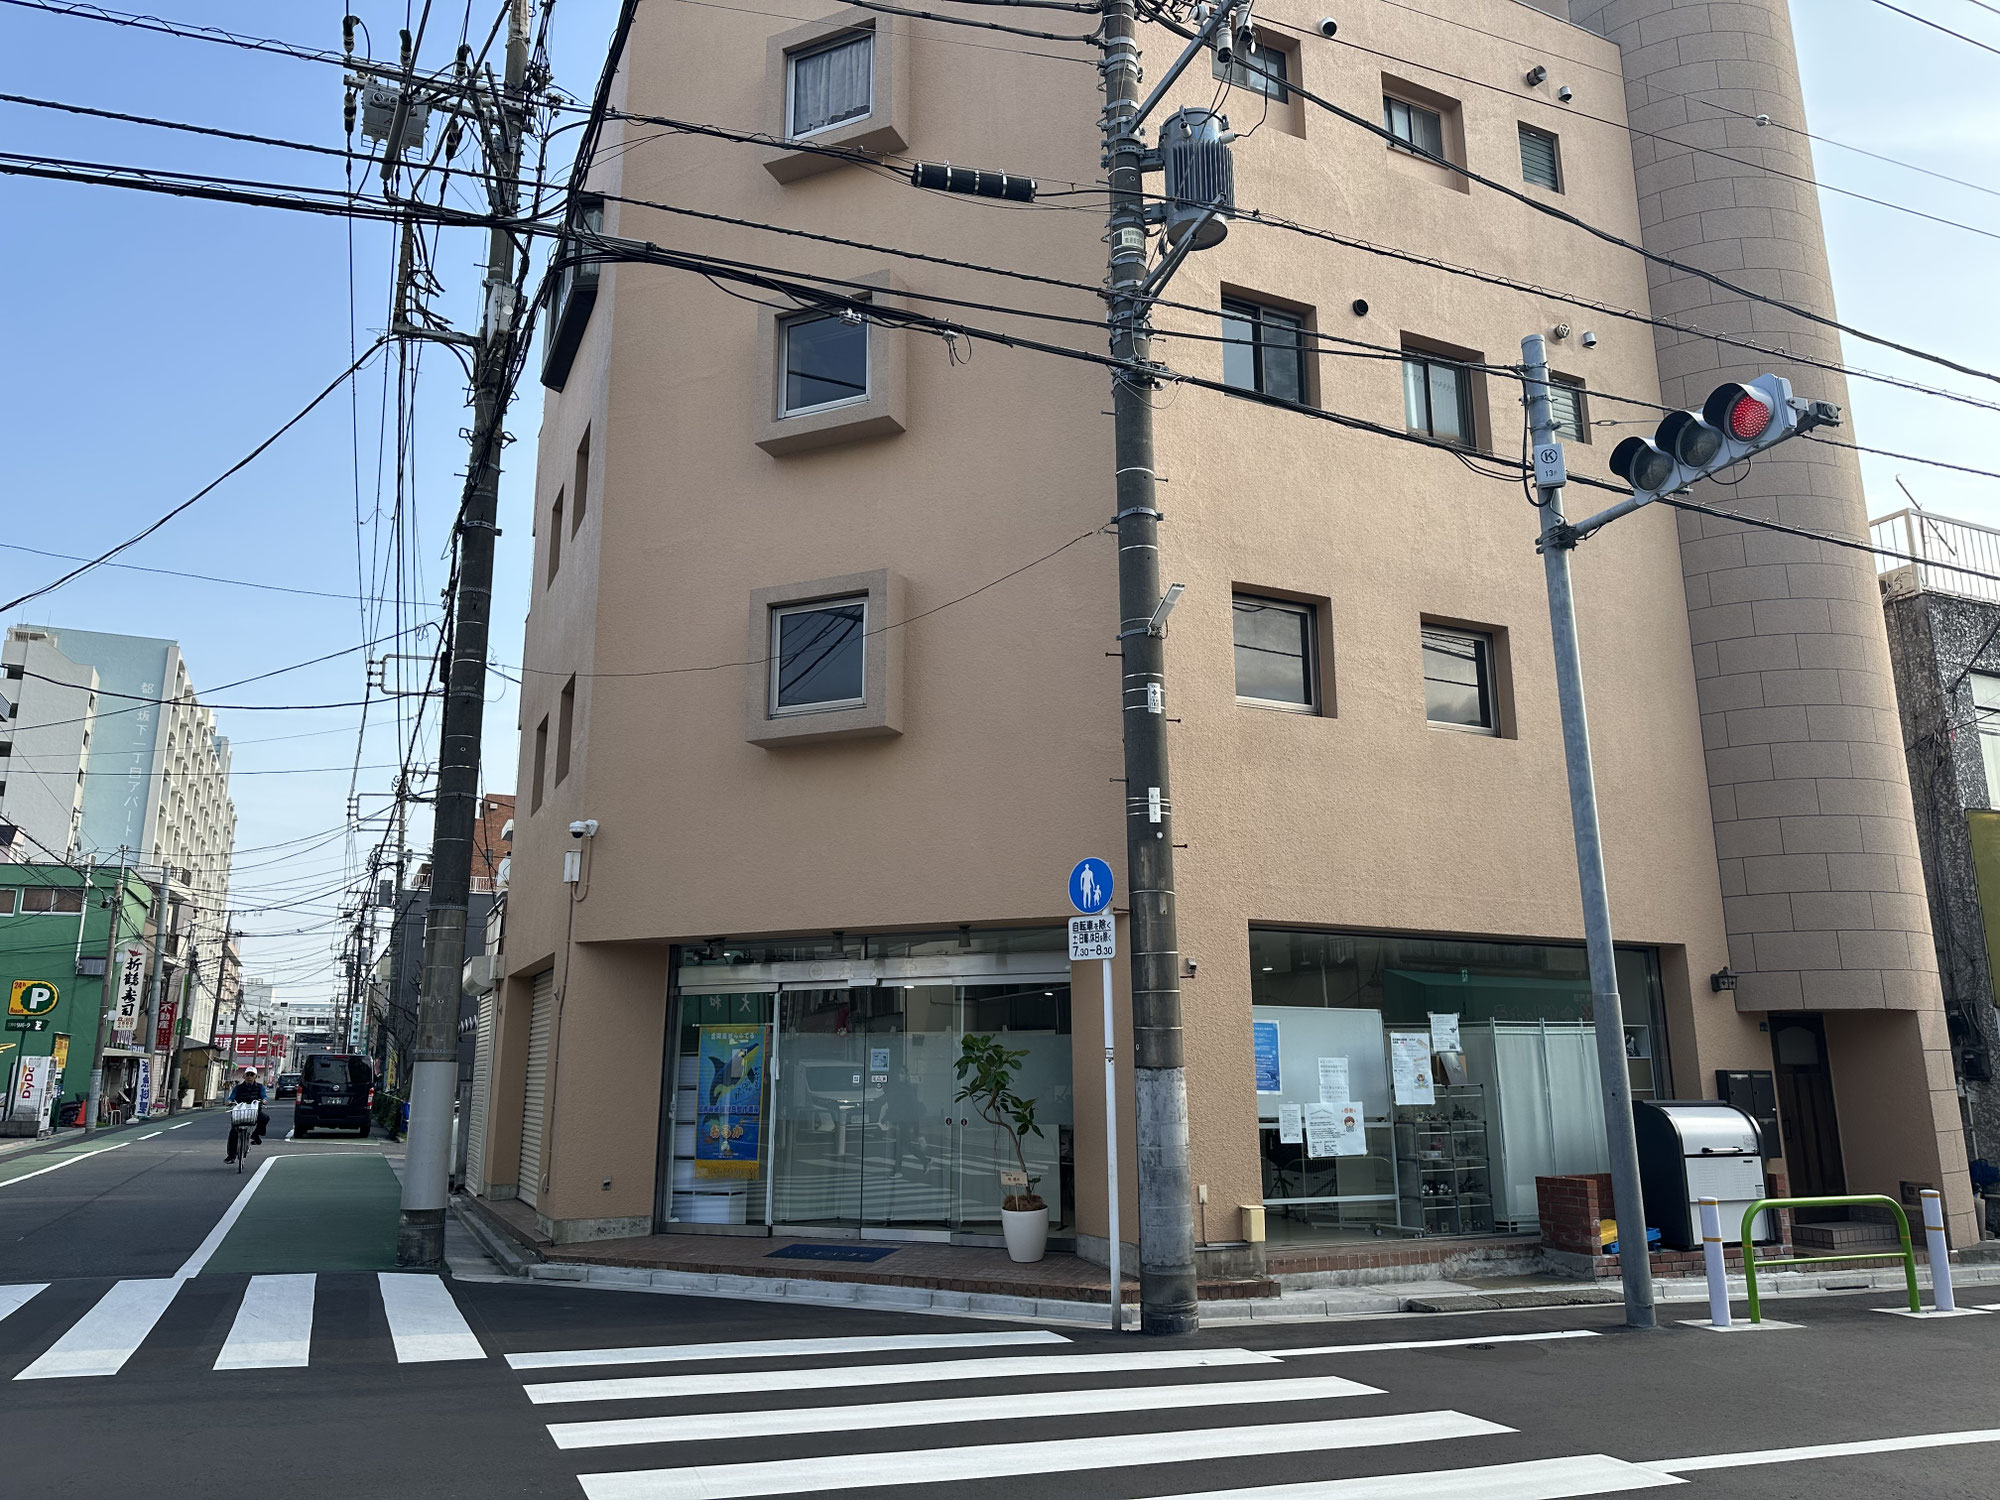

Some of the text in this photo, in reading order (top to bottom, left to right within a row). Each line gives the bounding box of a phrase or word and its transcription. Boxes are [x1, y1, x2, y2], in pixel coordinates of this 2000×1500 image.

[1072, 919, 1111, 932] 自転車を除く
[30, 987, 51, 1009] P
[121, 957, 142, 1017] 折鶴寿司
[159, 1003, 172, 1029] 不動産
[709, 1124, 744, 1140] おるか
